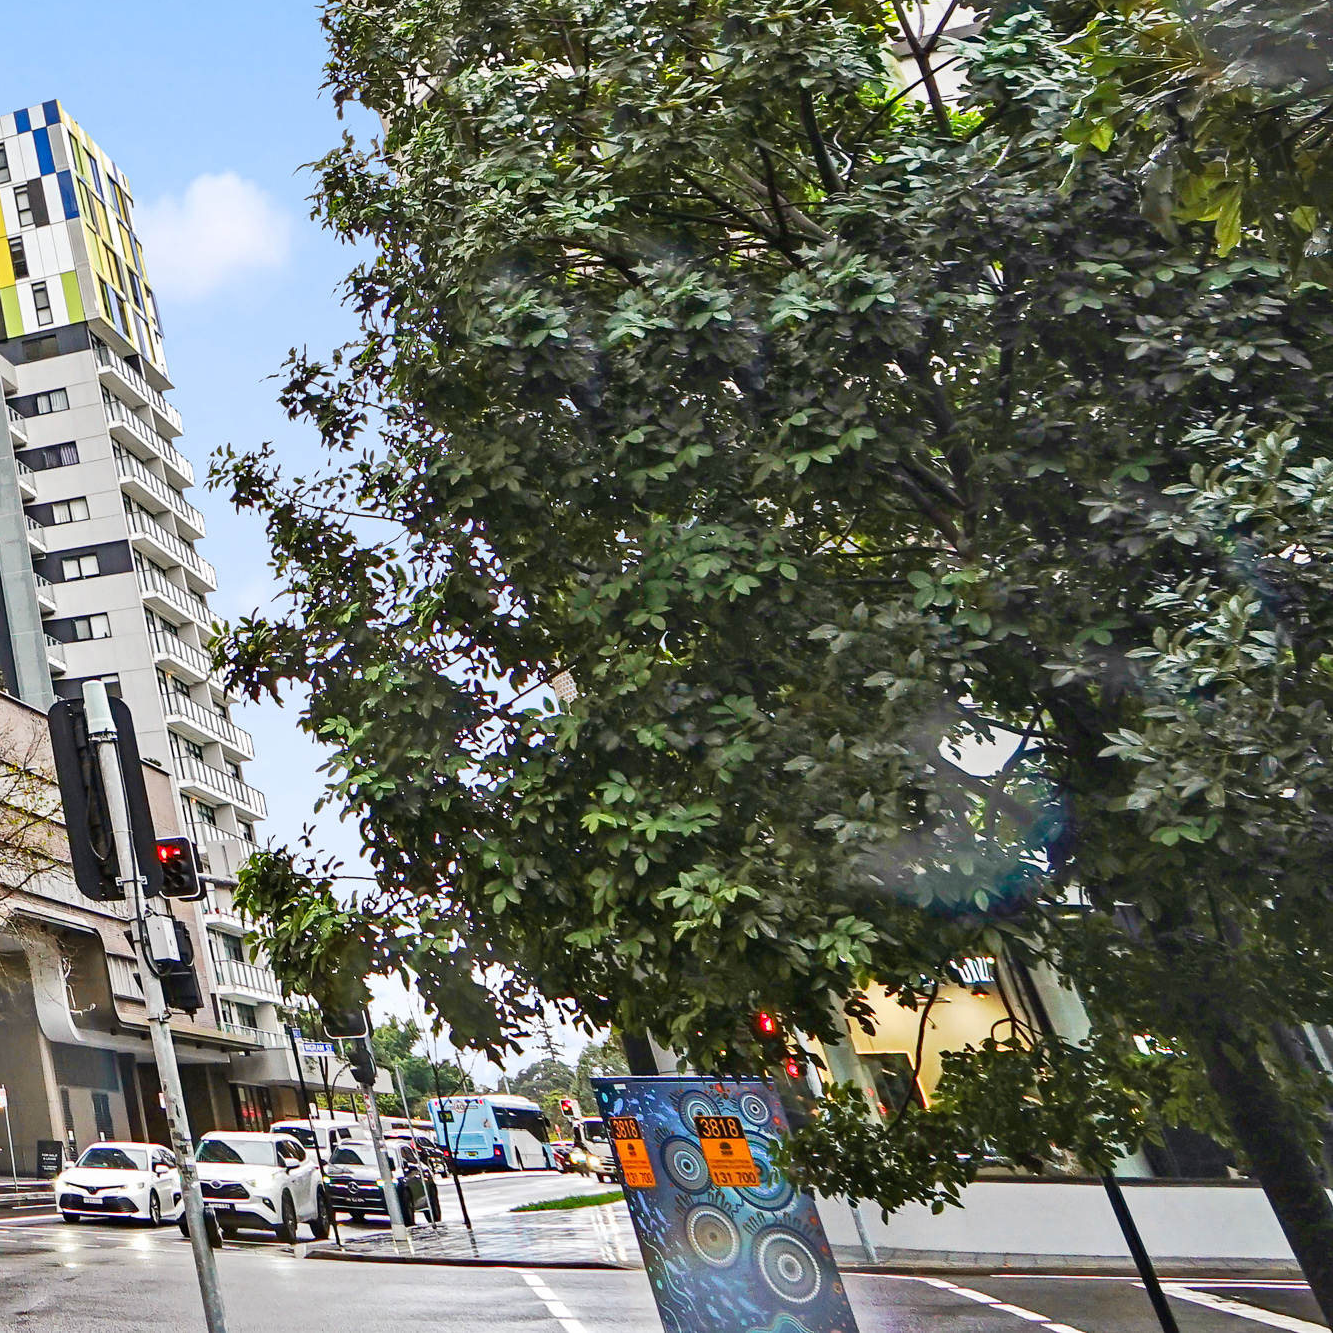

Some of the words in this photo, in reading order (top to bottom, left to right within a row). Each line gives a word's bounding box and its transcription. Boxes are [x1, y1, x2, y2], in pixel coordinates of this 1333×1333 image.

[613, 1120, 639, 1139] 3818
[699, 1118, 739, 1137] 3818
[714, 1172, 733, 1184] 131
[735, 1171, 757, 1184] 700
